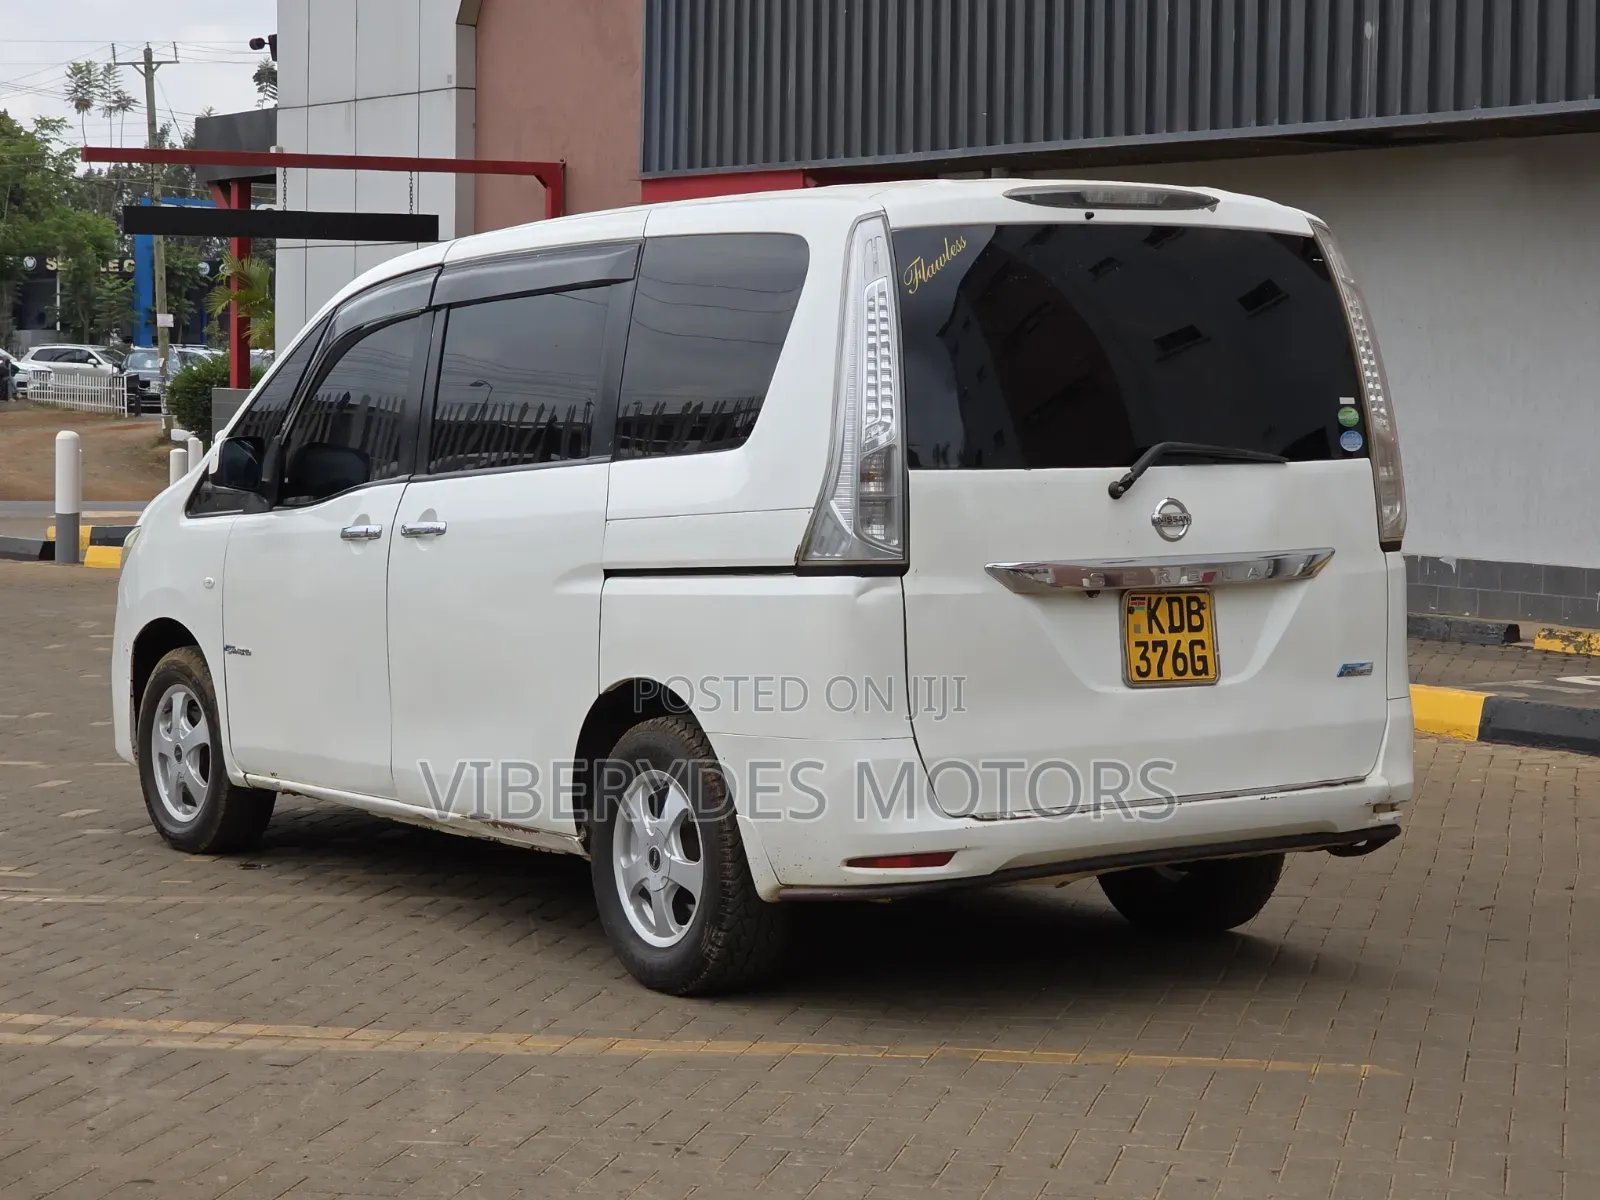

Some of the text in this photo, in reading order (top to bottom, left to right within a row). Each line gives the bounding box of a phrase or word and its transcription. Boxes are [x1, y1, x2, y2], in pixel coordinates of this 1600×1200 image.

[903, 235, 967, 294] Flawless
[1157, 514, 1189, 525] NISSAN
[1089, 564, 1263, 588] SERENA
[1146, 595, 1205, 634] KDB
[1134, 639, 1209, 678] 376G
